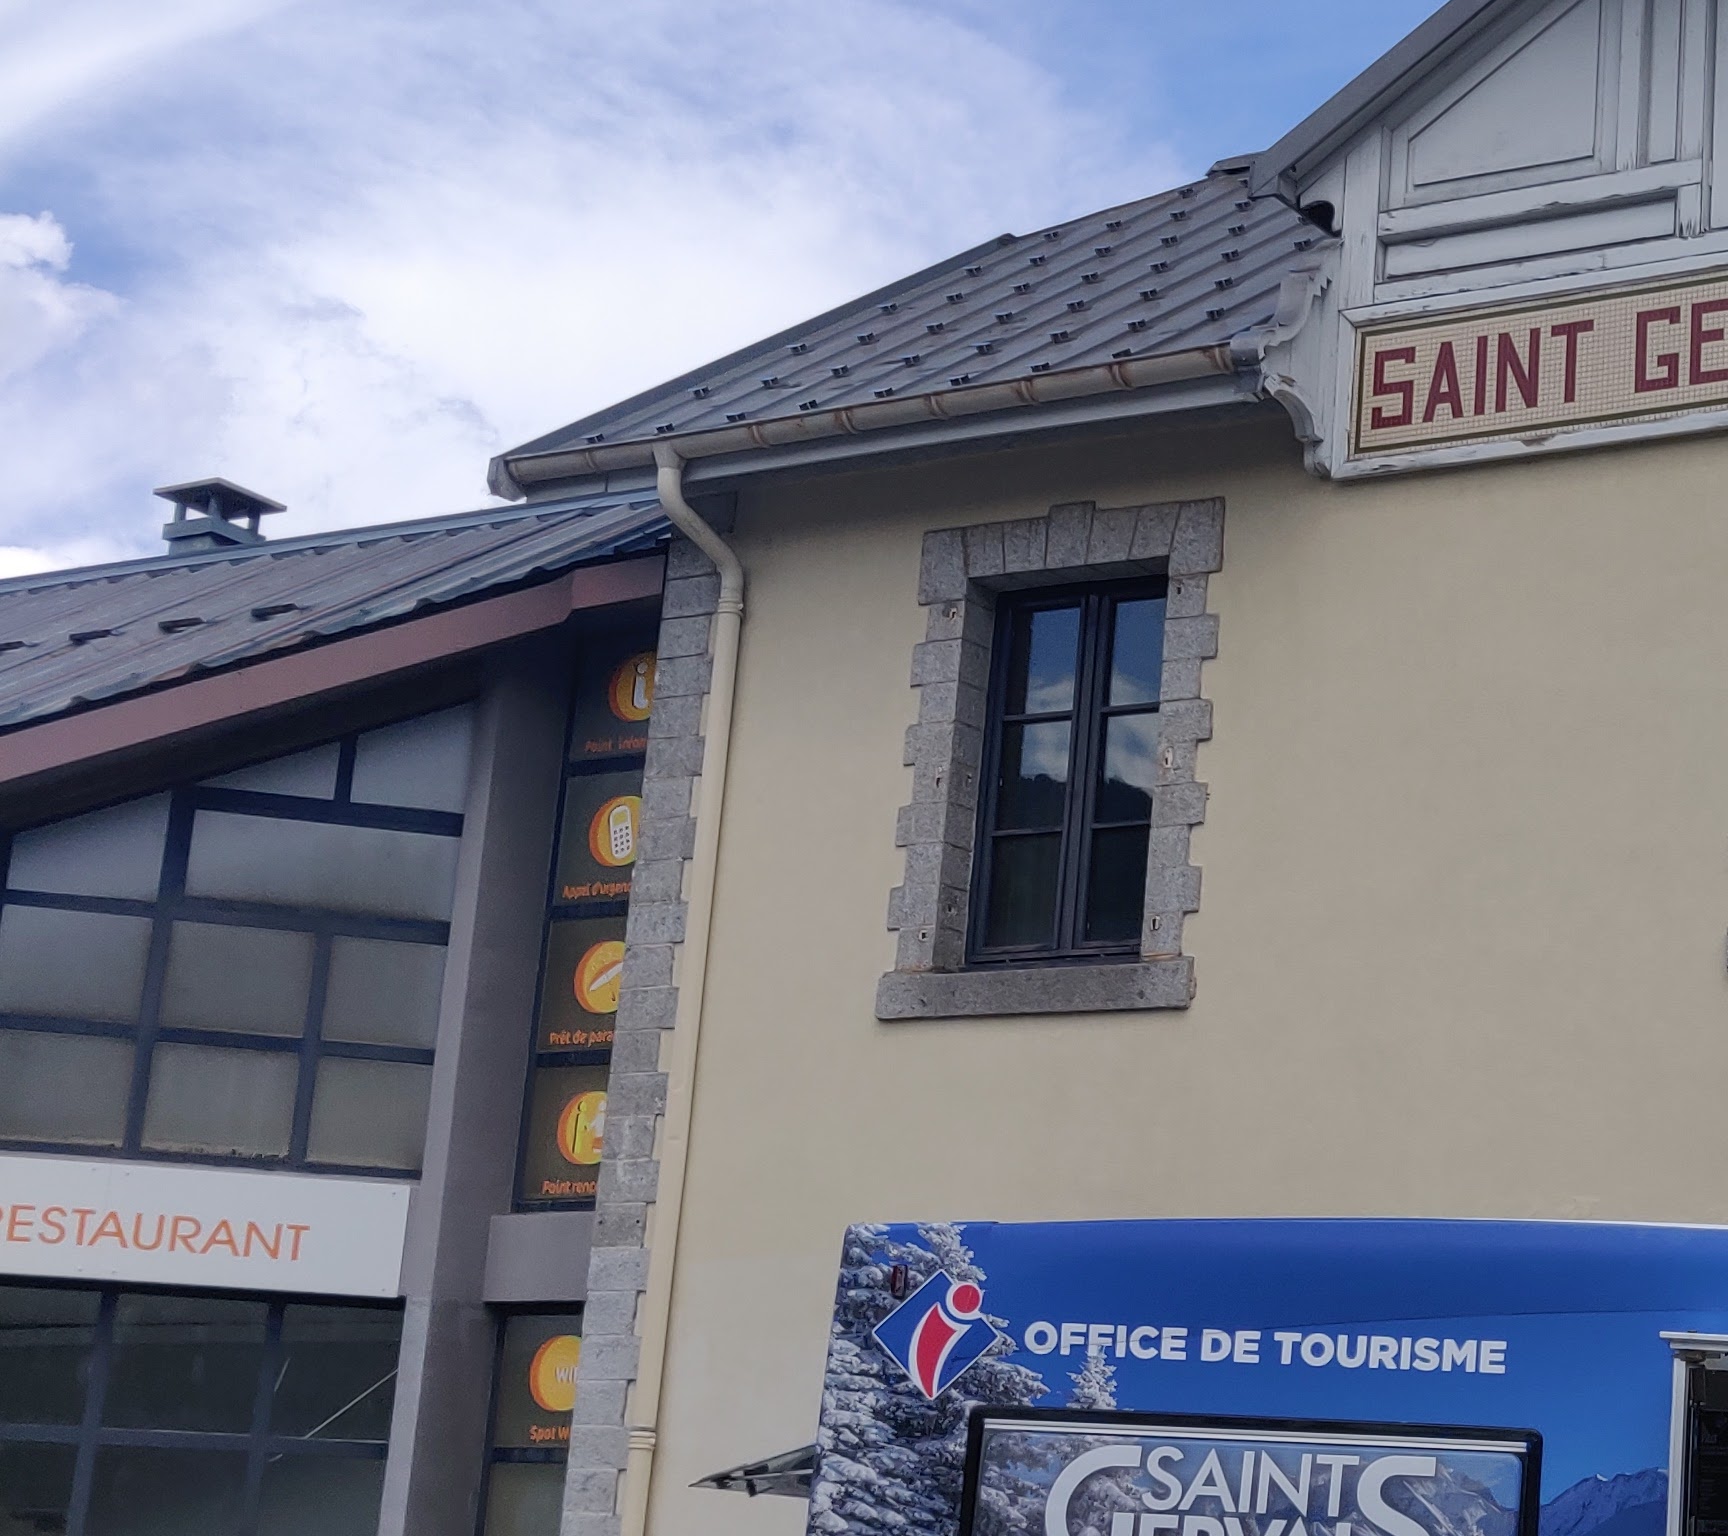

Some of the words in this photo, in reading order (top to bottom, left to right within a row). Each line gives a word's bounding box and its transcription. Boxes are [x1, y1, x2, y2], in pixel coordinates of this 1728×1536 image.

[1370, 318, 1595, 430] SAINT
[0, 1203, 311, 1261] ESTAURANT
[1023, 1320, 1189, 1362] OFFICE
[1200, 1327, 1262, 1365] DE
[1273, 1330, 1509, 1375] TOURISME
[1140, 1445, 1361, 1518] SAINT
